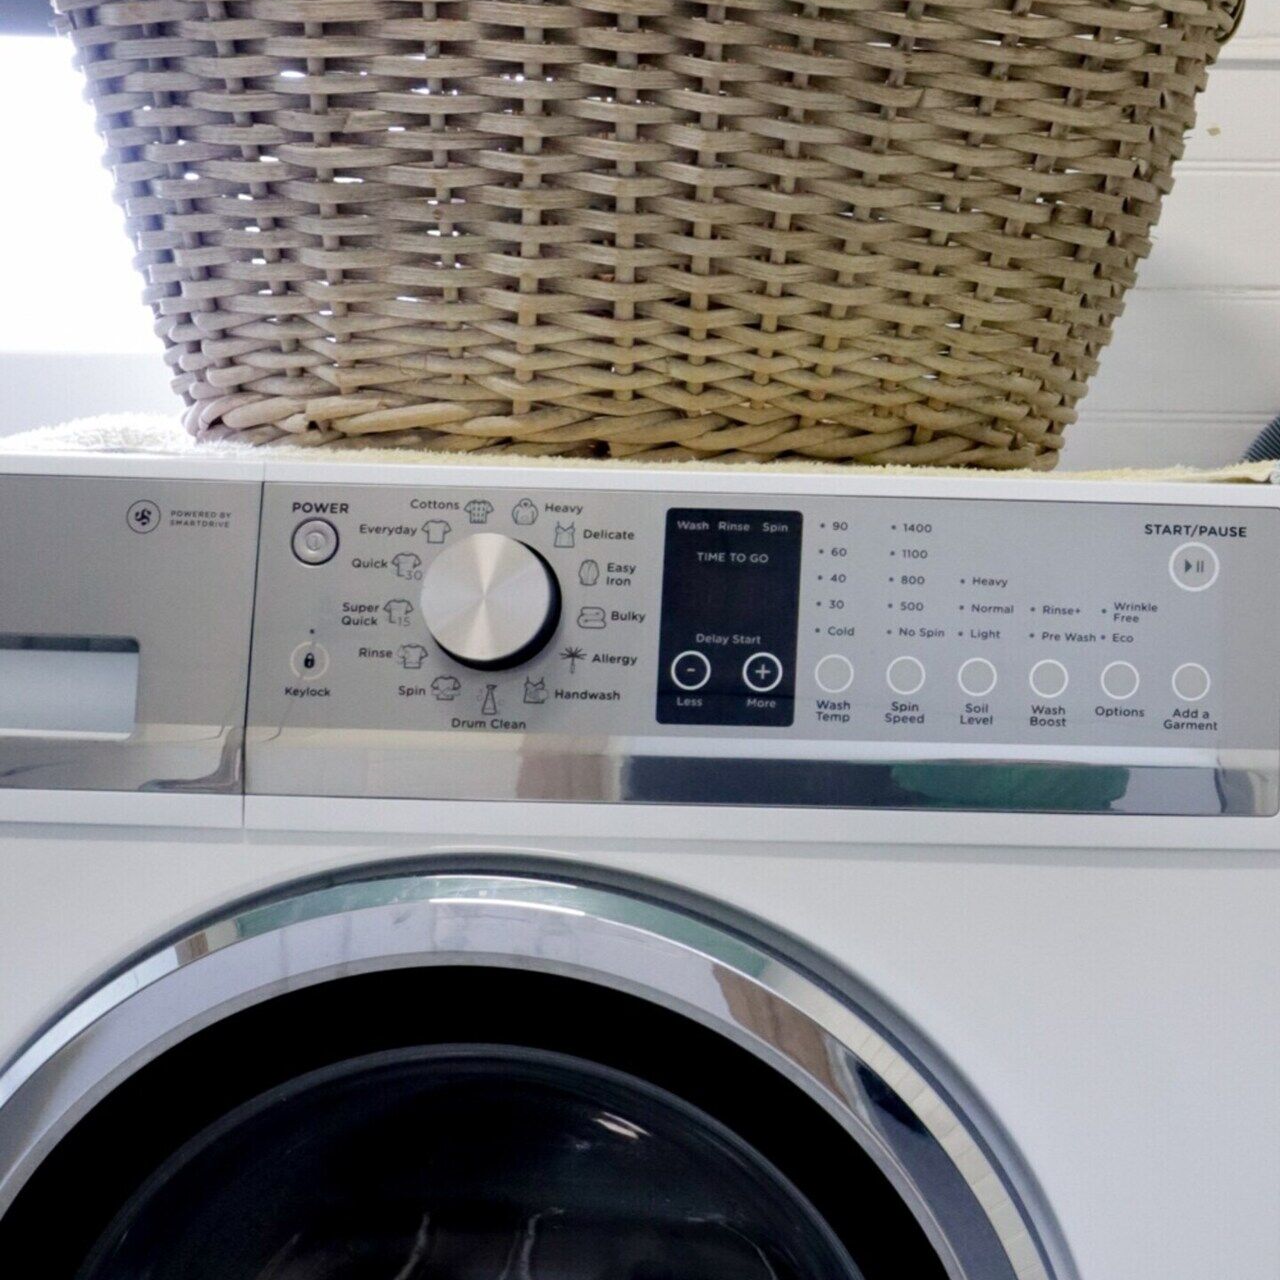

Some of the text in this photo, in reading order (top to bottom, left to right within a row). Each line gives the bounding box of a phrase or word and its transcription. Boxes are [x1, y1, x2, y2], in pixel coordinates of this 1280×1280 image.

[292, 502, 349, 514] POWER
[410, 499, 460, 510] Cottons
[544, 503, 583, 515] Heavy
[170, 510, 217, 519] POWERED
[170, 520, 230, 528] SMARTDRIVE
[677, 520, 710, 531] Wash
[718, 521, 750, 532] Rinse
[762, 522, 789, 533] Spin
[832, 521, 849, 531] 90
[903, 523, 933, 533] 1400
[359, 524, 417, 536] Everyday
[582, 529, 635, 540] Delicate
[1144, 523, 1248, 538] START/PAUSE
[697, 552, 769, 563] TIME TO GO
[830, 548, 848, 557] 60
[902, 549, 929, 559] 1100
[352, 558, 388, 569] Quick
[606, 562, 637, 575] Easy
[606, 576, 631, 586] Iron
[830, 574, 847, 583] 40
[900, 575, 926, 585] 800
[972, 576, 1008, 588] Heavy
[342, 602, 380, 614] Super
[828, 600, 845, 610] 30
[900, 601, 924, 611] 500
[971, 604, 1014, 614] Normal
[1042, 605, 1081, 615] Rinse+
[1114, 602, 1158, 613] Wrinkle
[341, 615, 378, 627] Quick
[611, 611, 646, 623] Bulky
[1113, 613, 1139, 623] Free
[827, 626, 855, 637] Cold
[899, 628, 945, 639] No Spin
[970, 629, 1001, 640] Light
[1041, 632, 1097, 642] Pre Wash
[696, 633, 761, 646] Delay Start
[1112, 634, 1134, 643] Eco
[358, 647, 393, 658] Rinse
[591, 653, 638, 666] Allergy
[284, 686, 331, 698] Keylock
[398, 685, 426, 697] Spin
[554, 689, 621, 701] Handwash
[676, 696, 703, 707] Less
[746, 698, 776, 709] More
[816, 700, 851, 710] Wash
[891, 701, 919, 713] Spin
[965, 703, 989, 713] Soil
[1031, 704, 1066, 716] Wash
[1095, 706, 1145, 718] Options
[1172, 708, 1199, 719] Add
[816, 711, 851, 723] Temp
[884, 713, 925, 724] Speed
[960, 715, 993, 725] Level
[1029, 716, 1067, 727] Boost
[451, 718, 526, 730] Drum Clean
[1163, 719, 1218, 731] Garment
